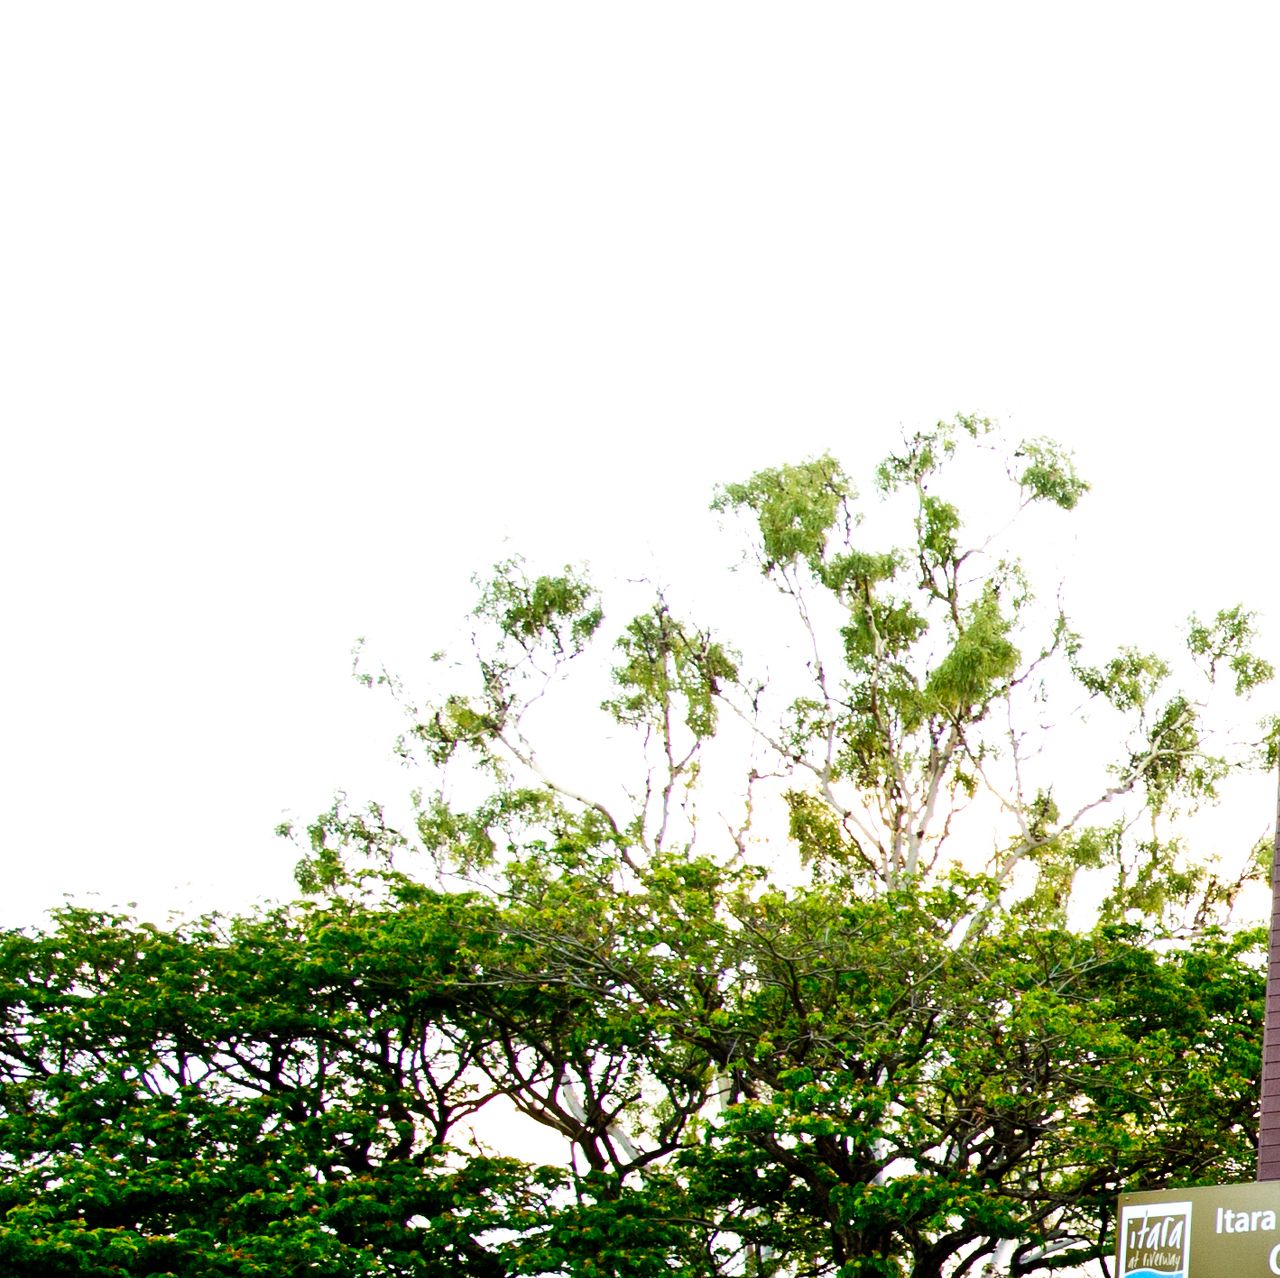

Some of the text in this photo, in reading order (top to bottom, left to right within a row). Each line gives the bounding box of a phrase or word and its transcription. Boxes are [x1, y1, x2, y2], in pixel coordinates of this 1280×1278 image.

[1127, 1209, 1184, 1251] itara
[1215, 1207, 1277, 1234] Itara
[1128, 1250, 1181, 1273] at riverway
